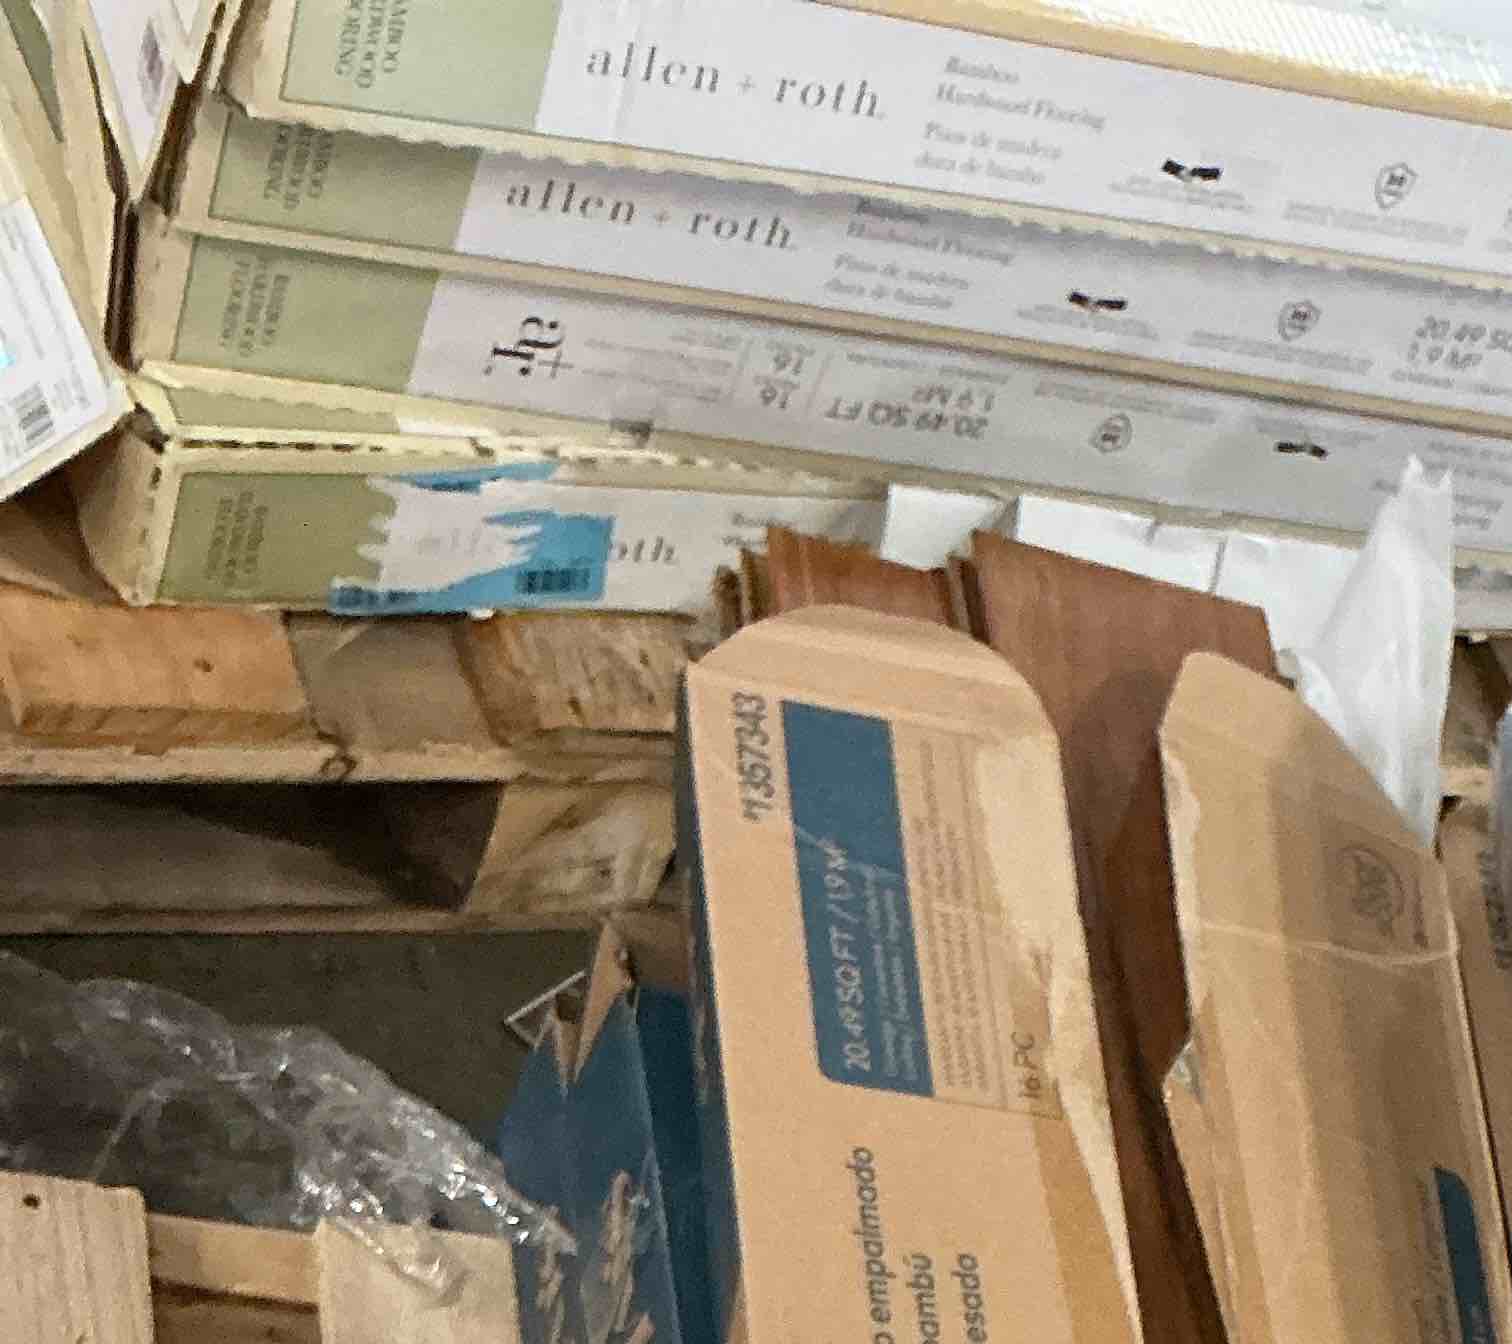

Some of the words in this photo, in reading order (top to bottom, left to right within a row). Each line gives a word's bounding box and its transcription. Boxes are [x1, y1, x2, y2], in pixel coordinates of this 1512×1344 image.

[585, 41, 720, 94] allen
[774, 76, 880, 119] roth
[506, 178, 636, 226] allen
[688, 210, 791, 249] roth
[848, 1146, 897, 1322] empalmado
